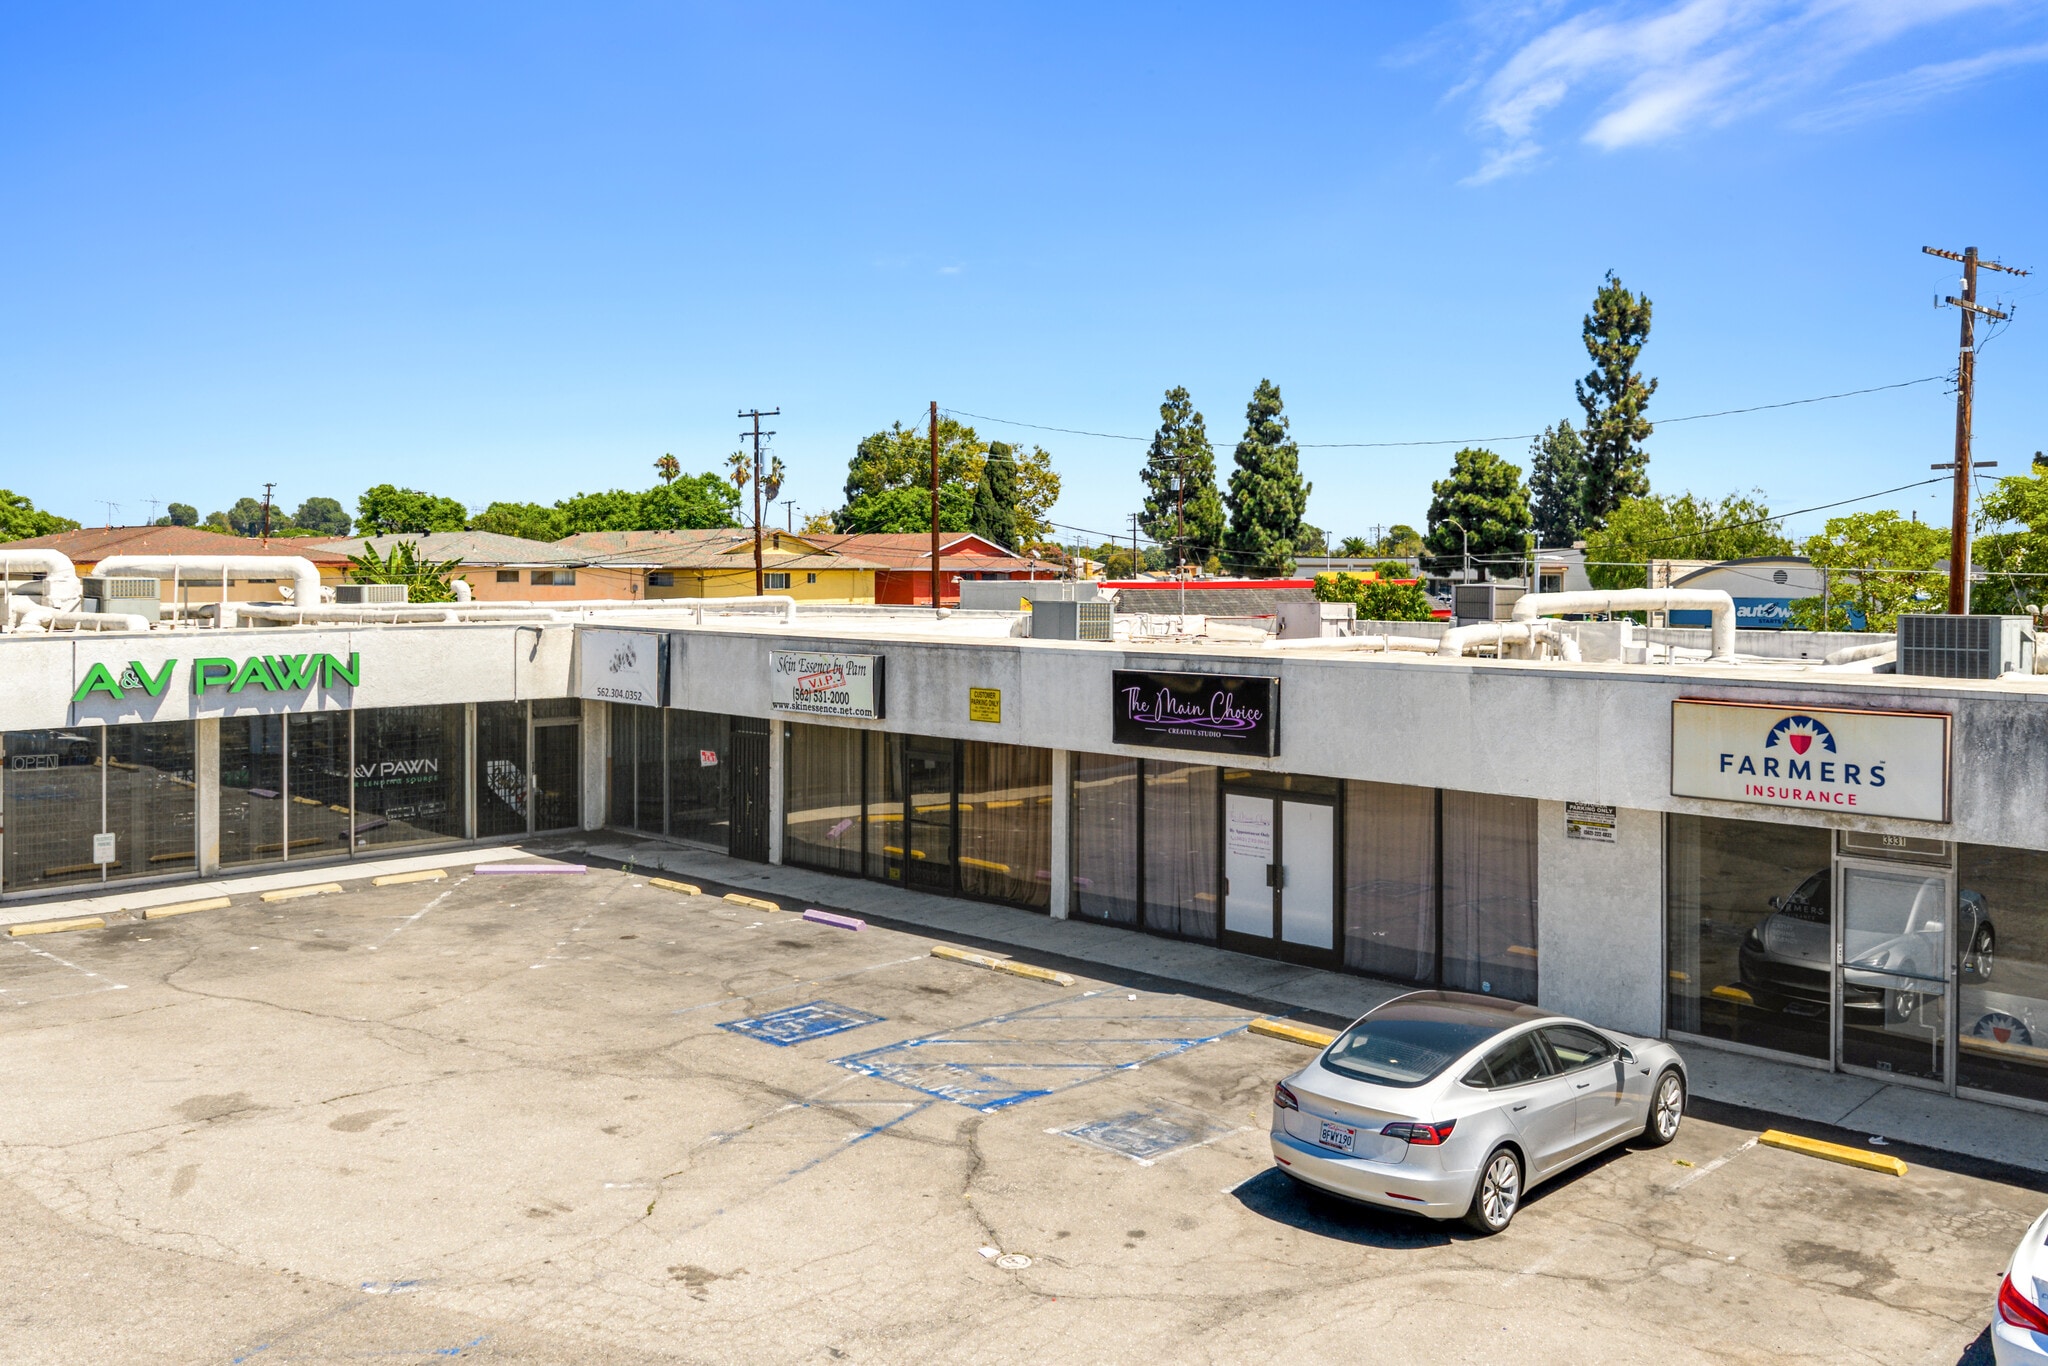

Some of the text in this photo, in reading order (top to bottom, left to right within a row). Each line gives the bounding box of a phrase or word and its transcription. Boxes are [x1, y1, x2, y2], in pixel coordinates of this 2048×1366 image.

[72, 651, 360, 702] A&V PAWN
[777, 655, 867, 682] Skin Essence by Pam
[597, 687, 642, 701] 562.304.0352
[793, 686, 850, 705] (562) 531-2000
[772, 702, 873, 716] www.skinessence.net.com
[1121, 686, 1263, 724] The Main Choice
[1168, 728, 1221, 738] CREATIVE STUDIO
[14, 756, 57, 770] OPEN
[380, 758, 438, 777] PAWN
[1720, 753, 1886, 787] FARMERS
[1745, 784, 1857, 806] INSURANCE
[1569, 805, 1596, 813] PARKING
[1883, 835, 1905, 846] 3331
[1322, 1128, 1352, 1146] 8FWY190
